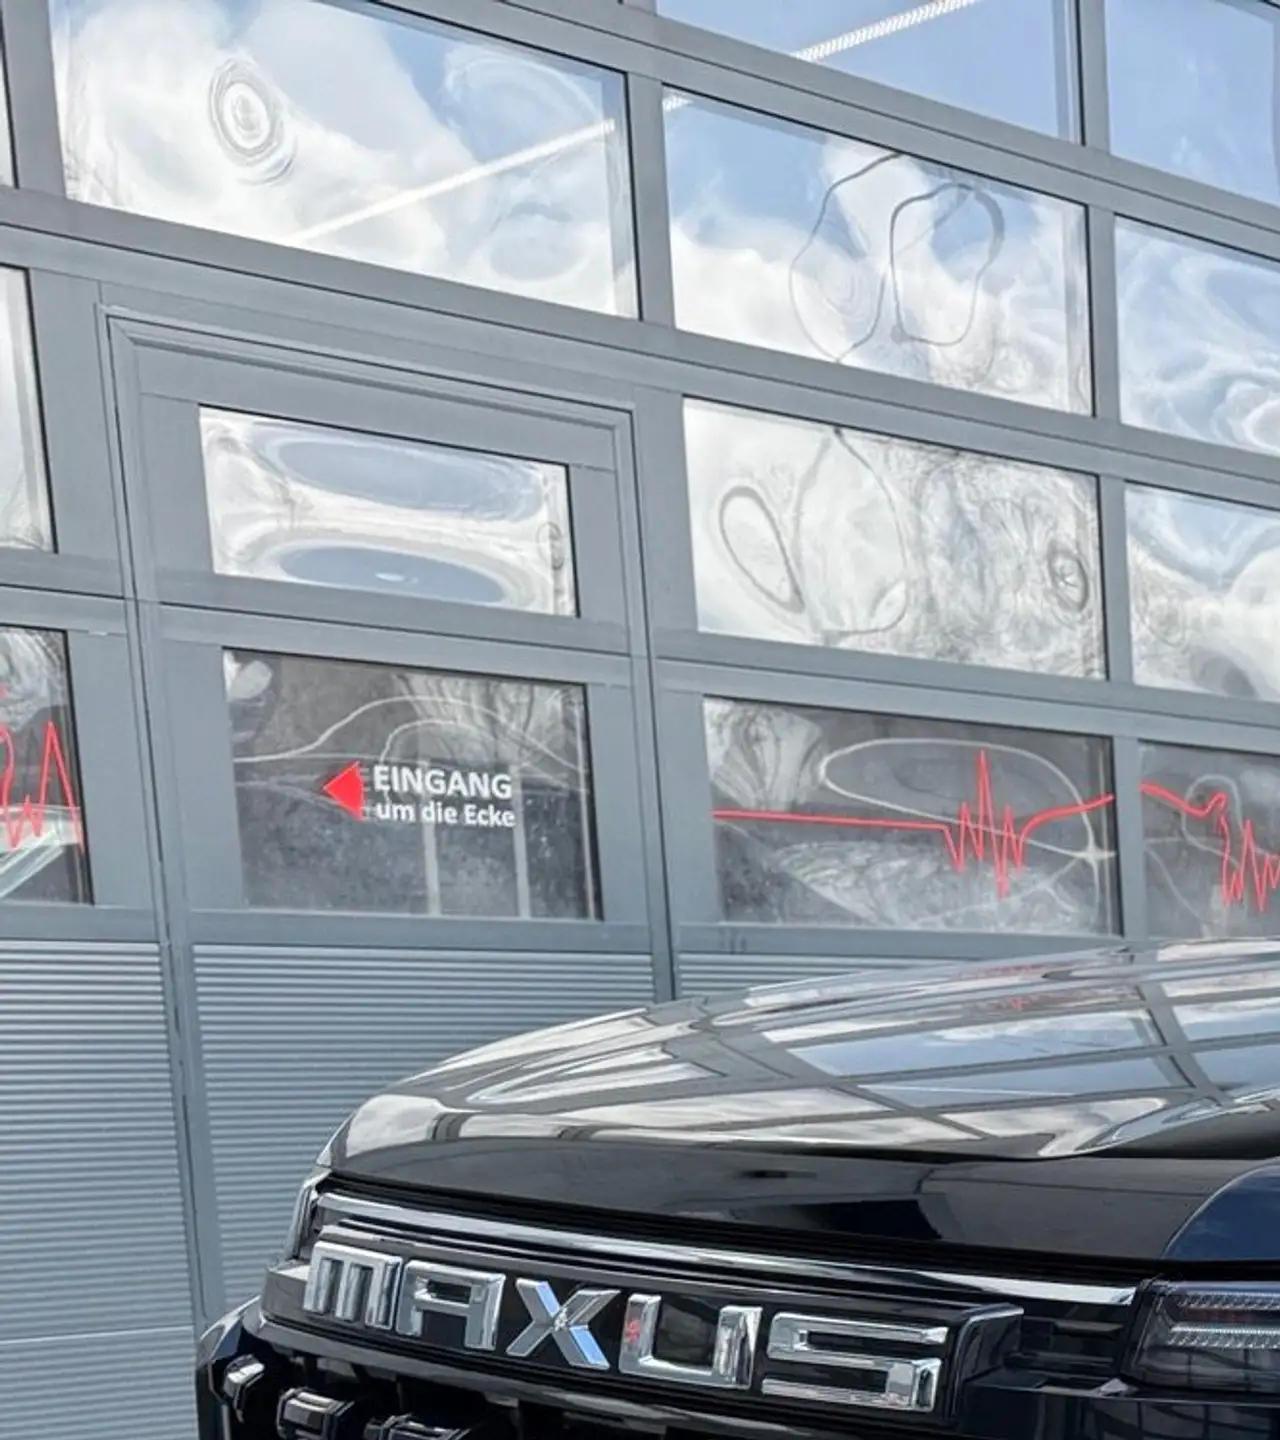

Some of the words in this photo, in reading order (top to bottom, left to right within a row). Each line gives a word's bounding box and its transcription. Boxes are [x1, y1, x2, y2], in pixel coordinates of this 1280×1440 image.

[373, 765, 513, 800] EINGANG
[376, 802, 416, 823] um
[420, 800, 459, 825] die
[463, 803, 518, 828] Ecke
[303, 1240, 948, 1412] MAXUS
